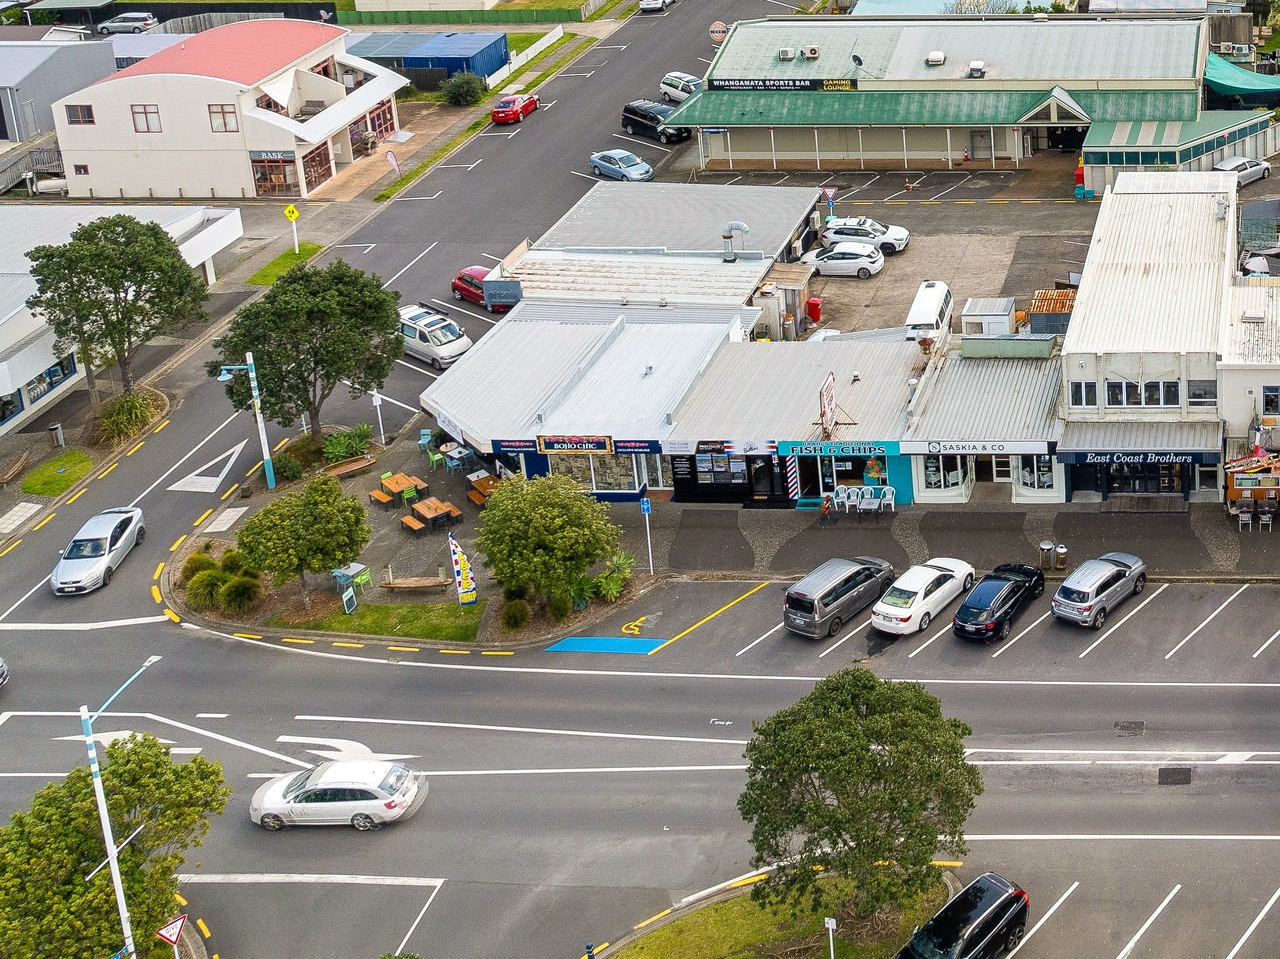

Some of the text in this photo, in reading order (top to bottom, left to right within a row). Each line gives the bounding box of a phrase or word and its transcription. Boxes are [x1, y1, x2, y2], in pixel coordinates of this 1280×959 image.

[790, 446, 824, 455] FISH
[840, 446, 886, 455] CHIPS
[1086, 453, 1193, 463] East Coast Brothers
[165, 923, 179, 934] GIVE
